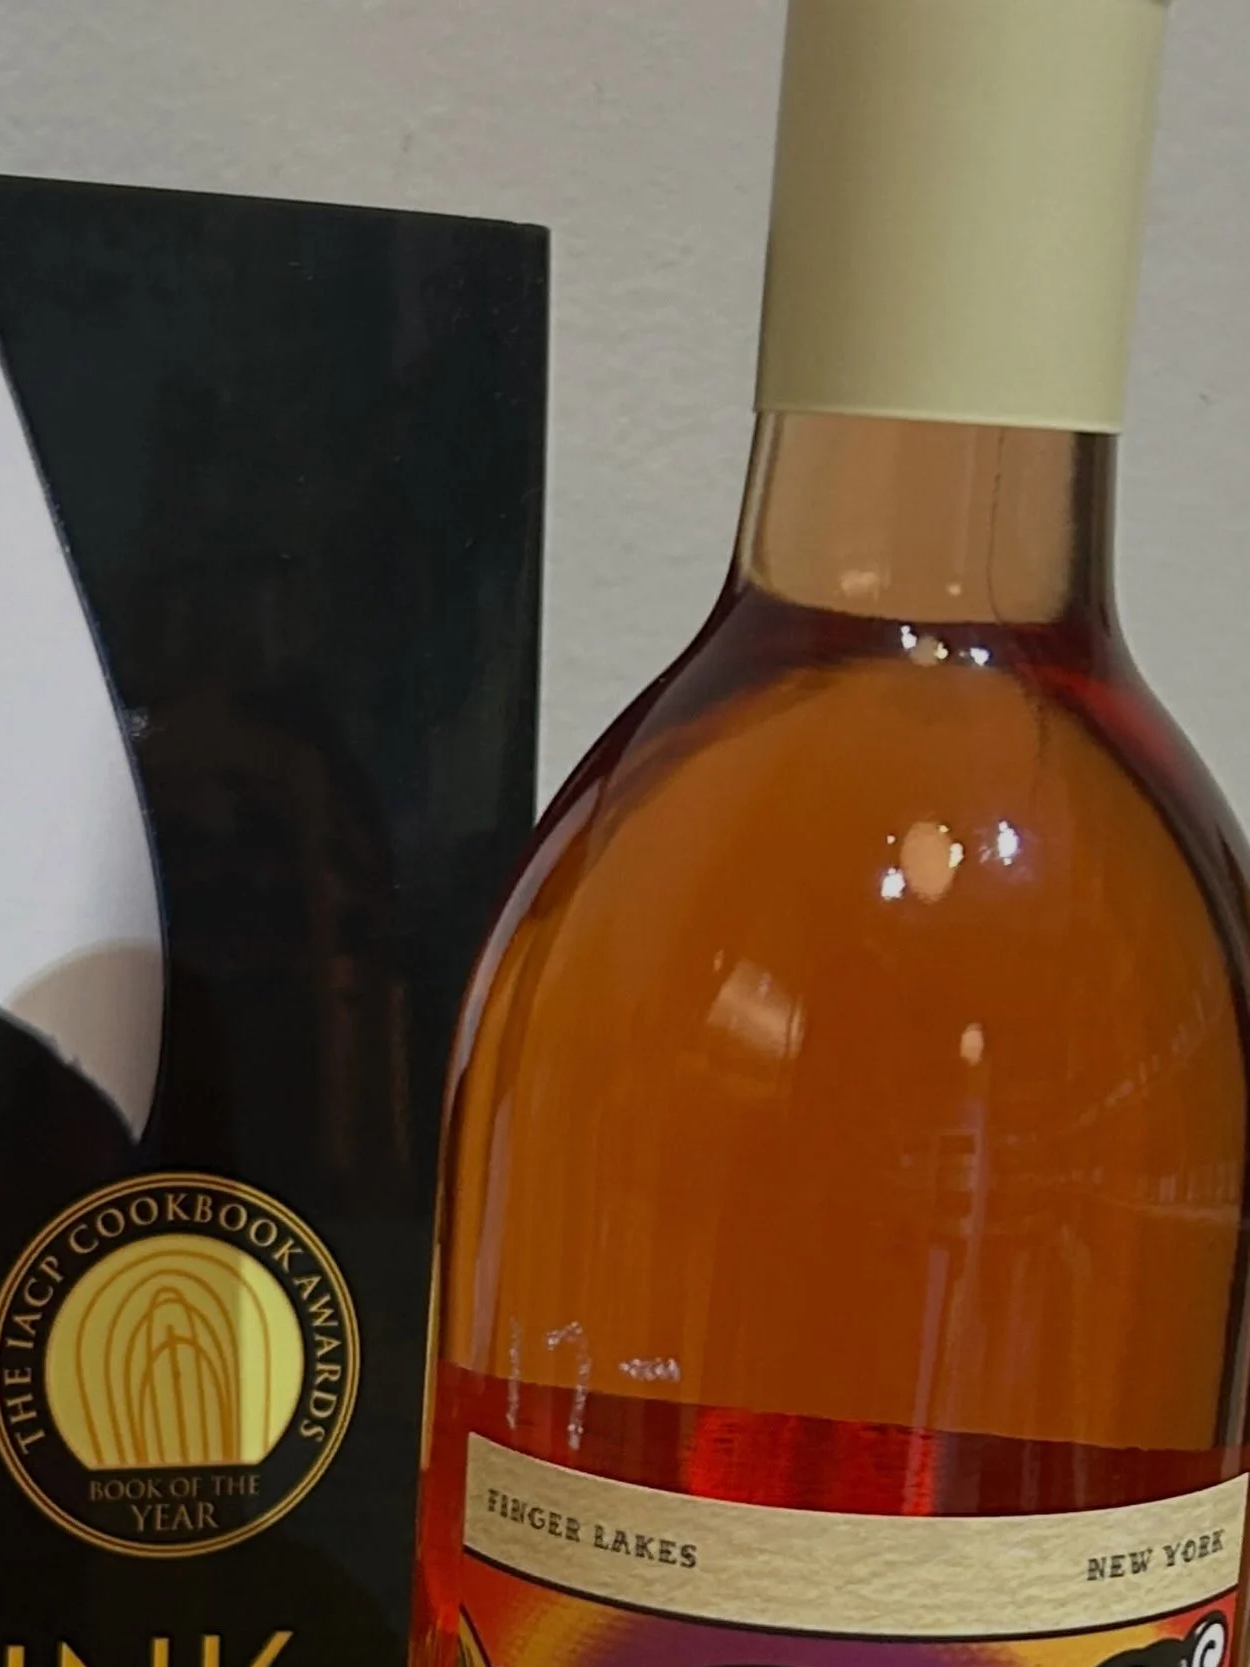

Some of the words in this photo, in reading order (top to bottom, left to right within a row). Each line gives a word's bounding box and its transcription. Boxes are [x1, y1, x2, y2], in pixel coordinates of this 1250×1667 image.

[69, 1193, 303, 1272] COOKBOOK
[7, 1255, 61, 1350] IACP
[294, 1274, 342, 1442] AWARDS
[6, 1367, 44, 1454] THE
[90, 1477, 163, 1501] BOOK
[170, 1476, 203, 1497] OF
[212, 1474, 260, 1496] THE
[131, 1503, 219, 1532] YEAR
[487, 1487, 581, 1542] FINGER
[592, 1522, 699, 1569] LAKES
[1086, 1548, 1154, 1582] NEW
[1162, 1529, 1225, 1567] YORK
